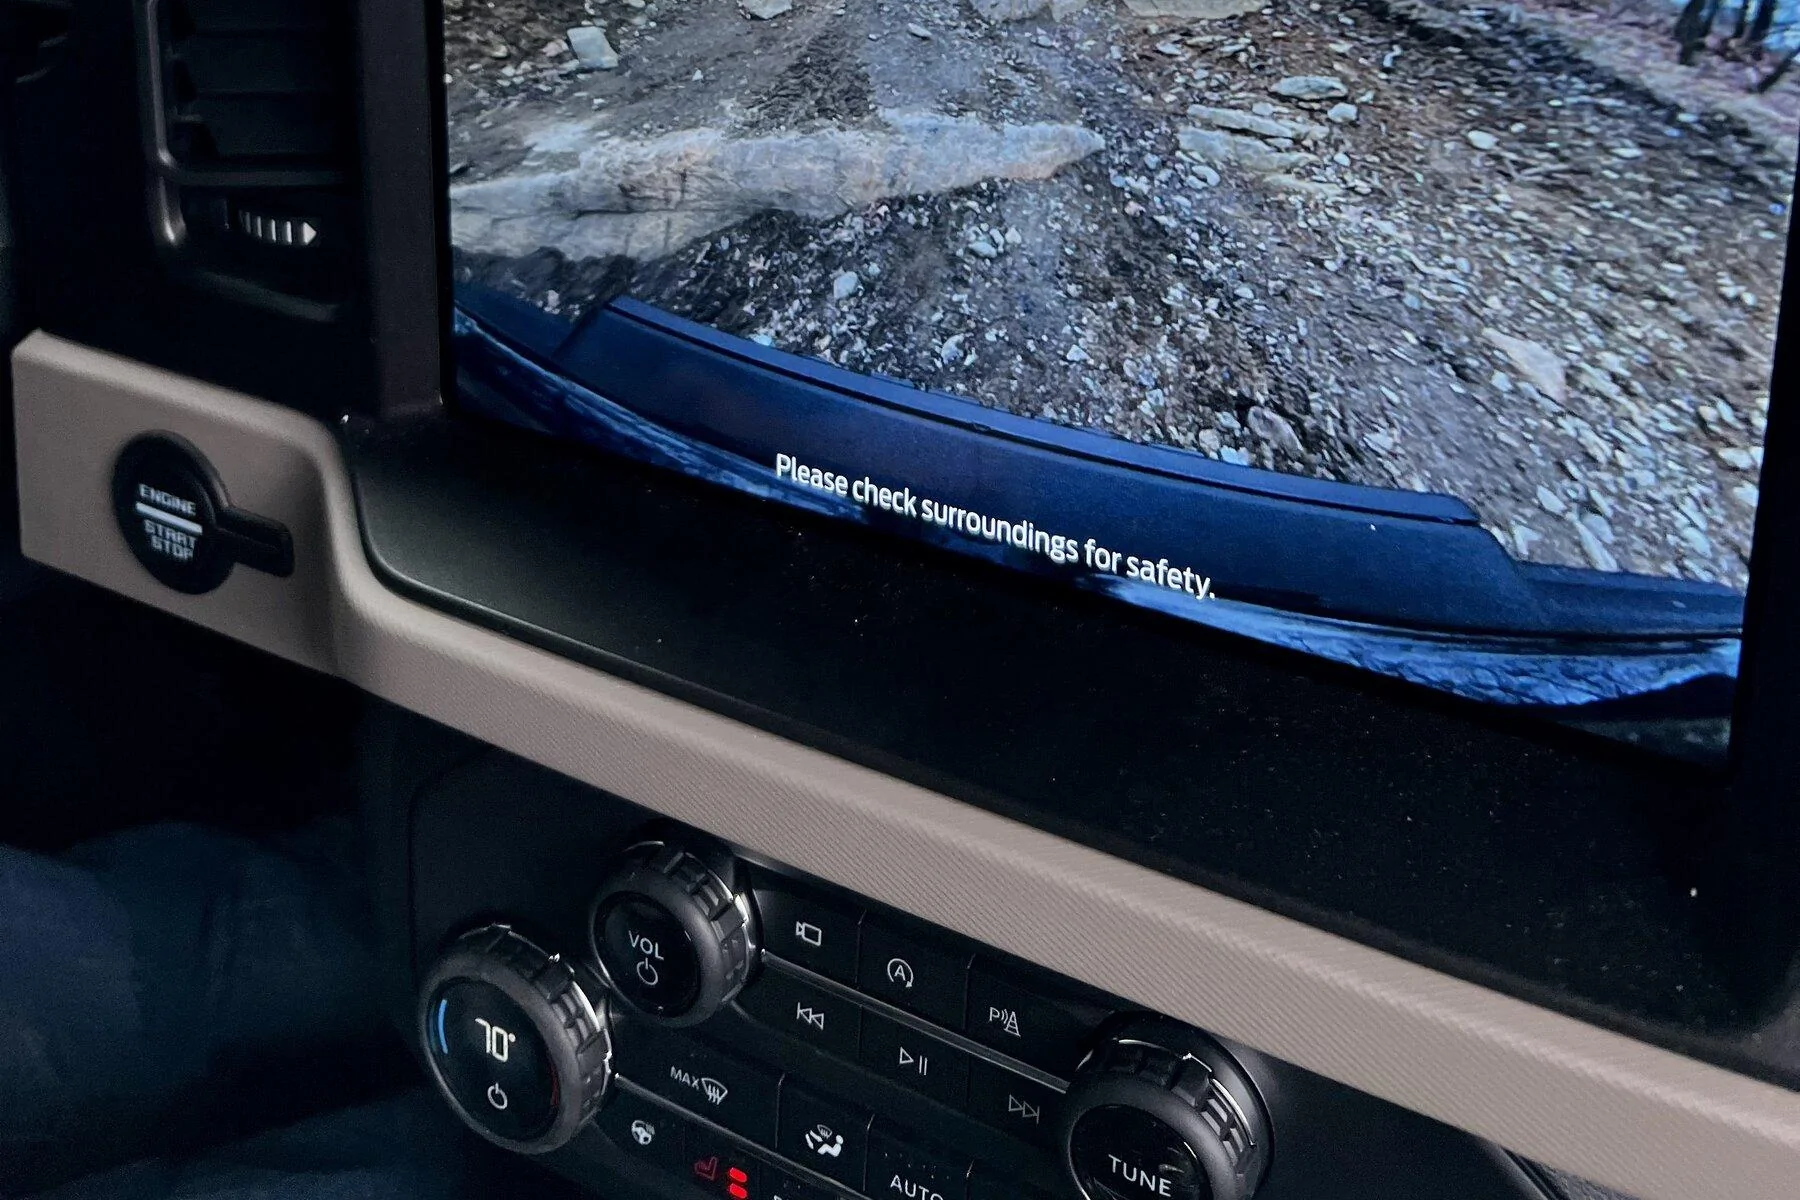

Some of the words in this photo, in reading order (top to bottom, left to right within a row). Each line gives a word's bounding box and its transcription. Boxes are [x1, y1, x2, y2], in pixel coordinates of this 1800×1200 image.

[139, 483, 197, 516] ENGINE
[144, 519, 197, 549] START
[775, 452, 849, 497] Please
[852, 476, 918, 518] check
[921, 498, 1079, 565] surroundings
[1084, 538, 1122, 573] for
[1126, 554, 1216, 600] safety.
[151, 535, 195, 560] STOP
[628, 929, 665, 961] VOL
[670, 1065, 700, 1091] MAX
[1108, 1153, 1172, 1198] TUNE
